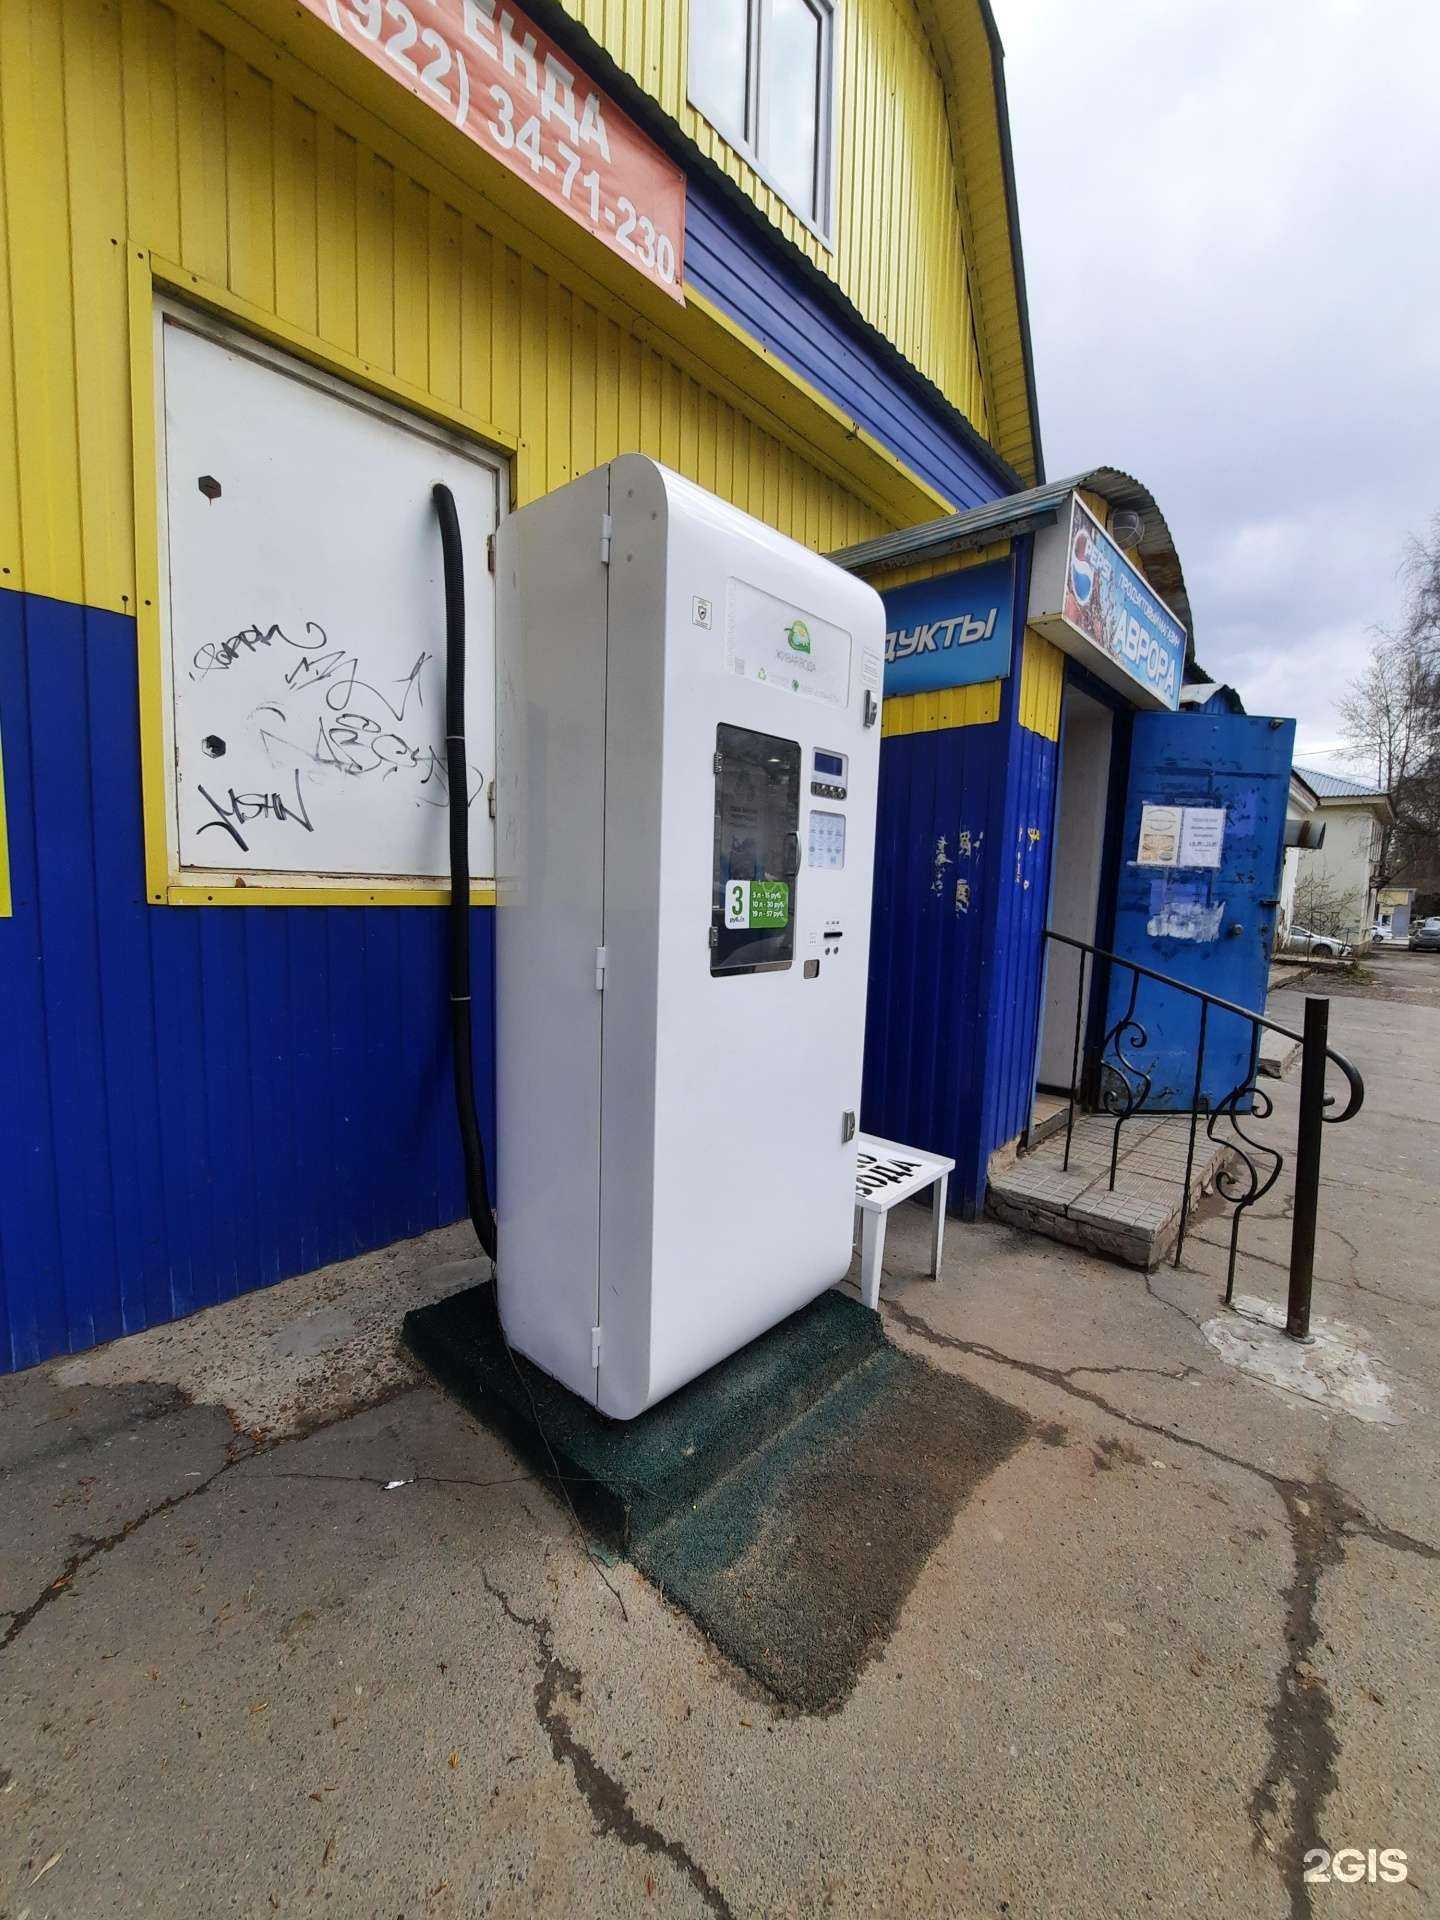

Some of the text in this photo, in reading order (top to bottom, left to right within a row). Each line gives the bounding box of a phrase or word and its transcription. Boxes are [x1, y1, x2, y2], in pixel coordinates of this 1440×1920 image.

[426, 0, 611, 164] ЕНДА
[488, 84, 675, 284] 34-71-230
[1112, 609, 1176, 700] АВРОРА
[731, 885, 743, 916] 3
